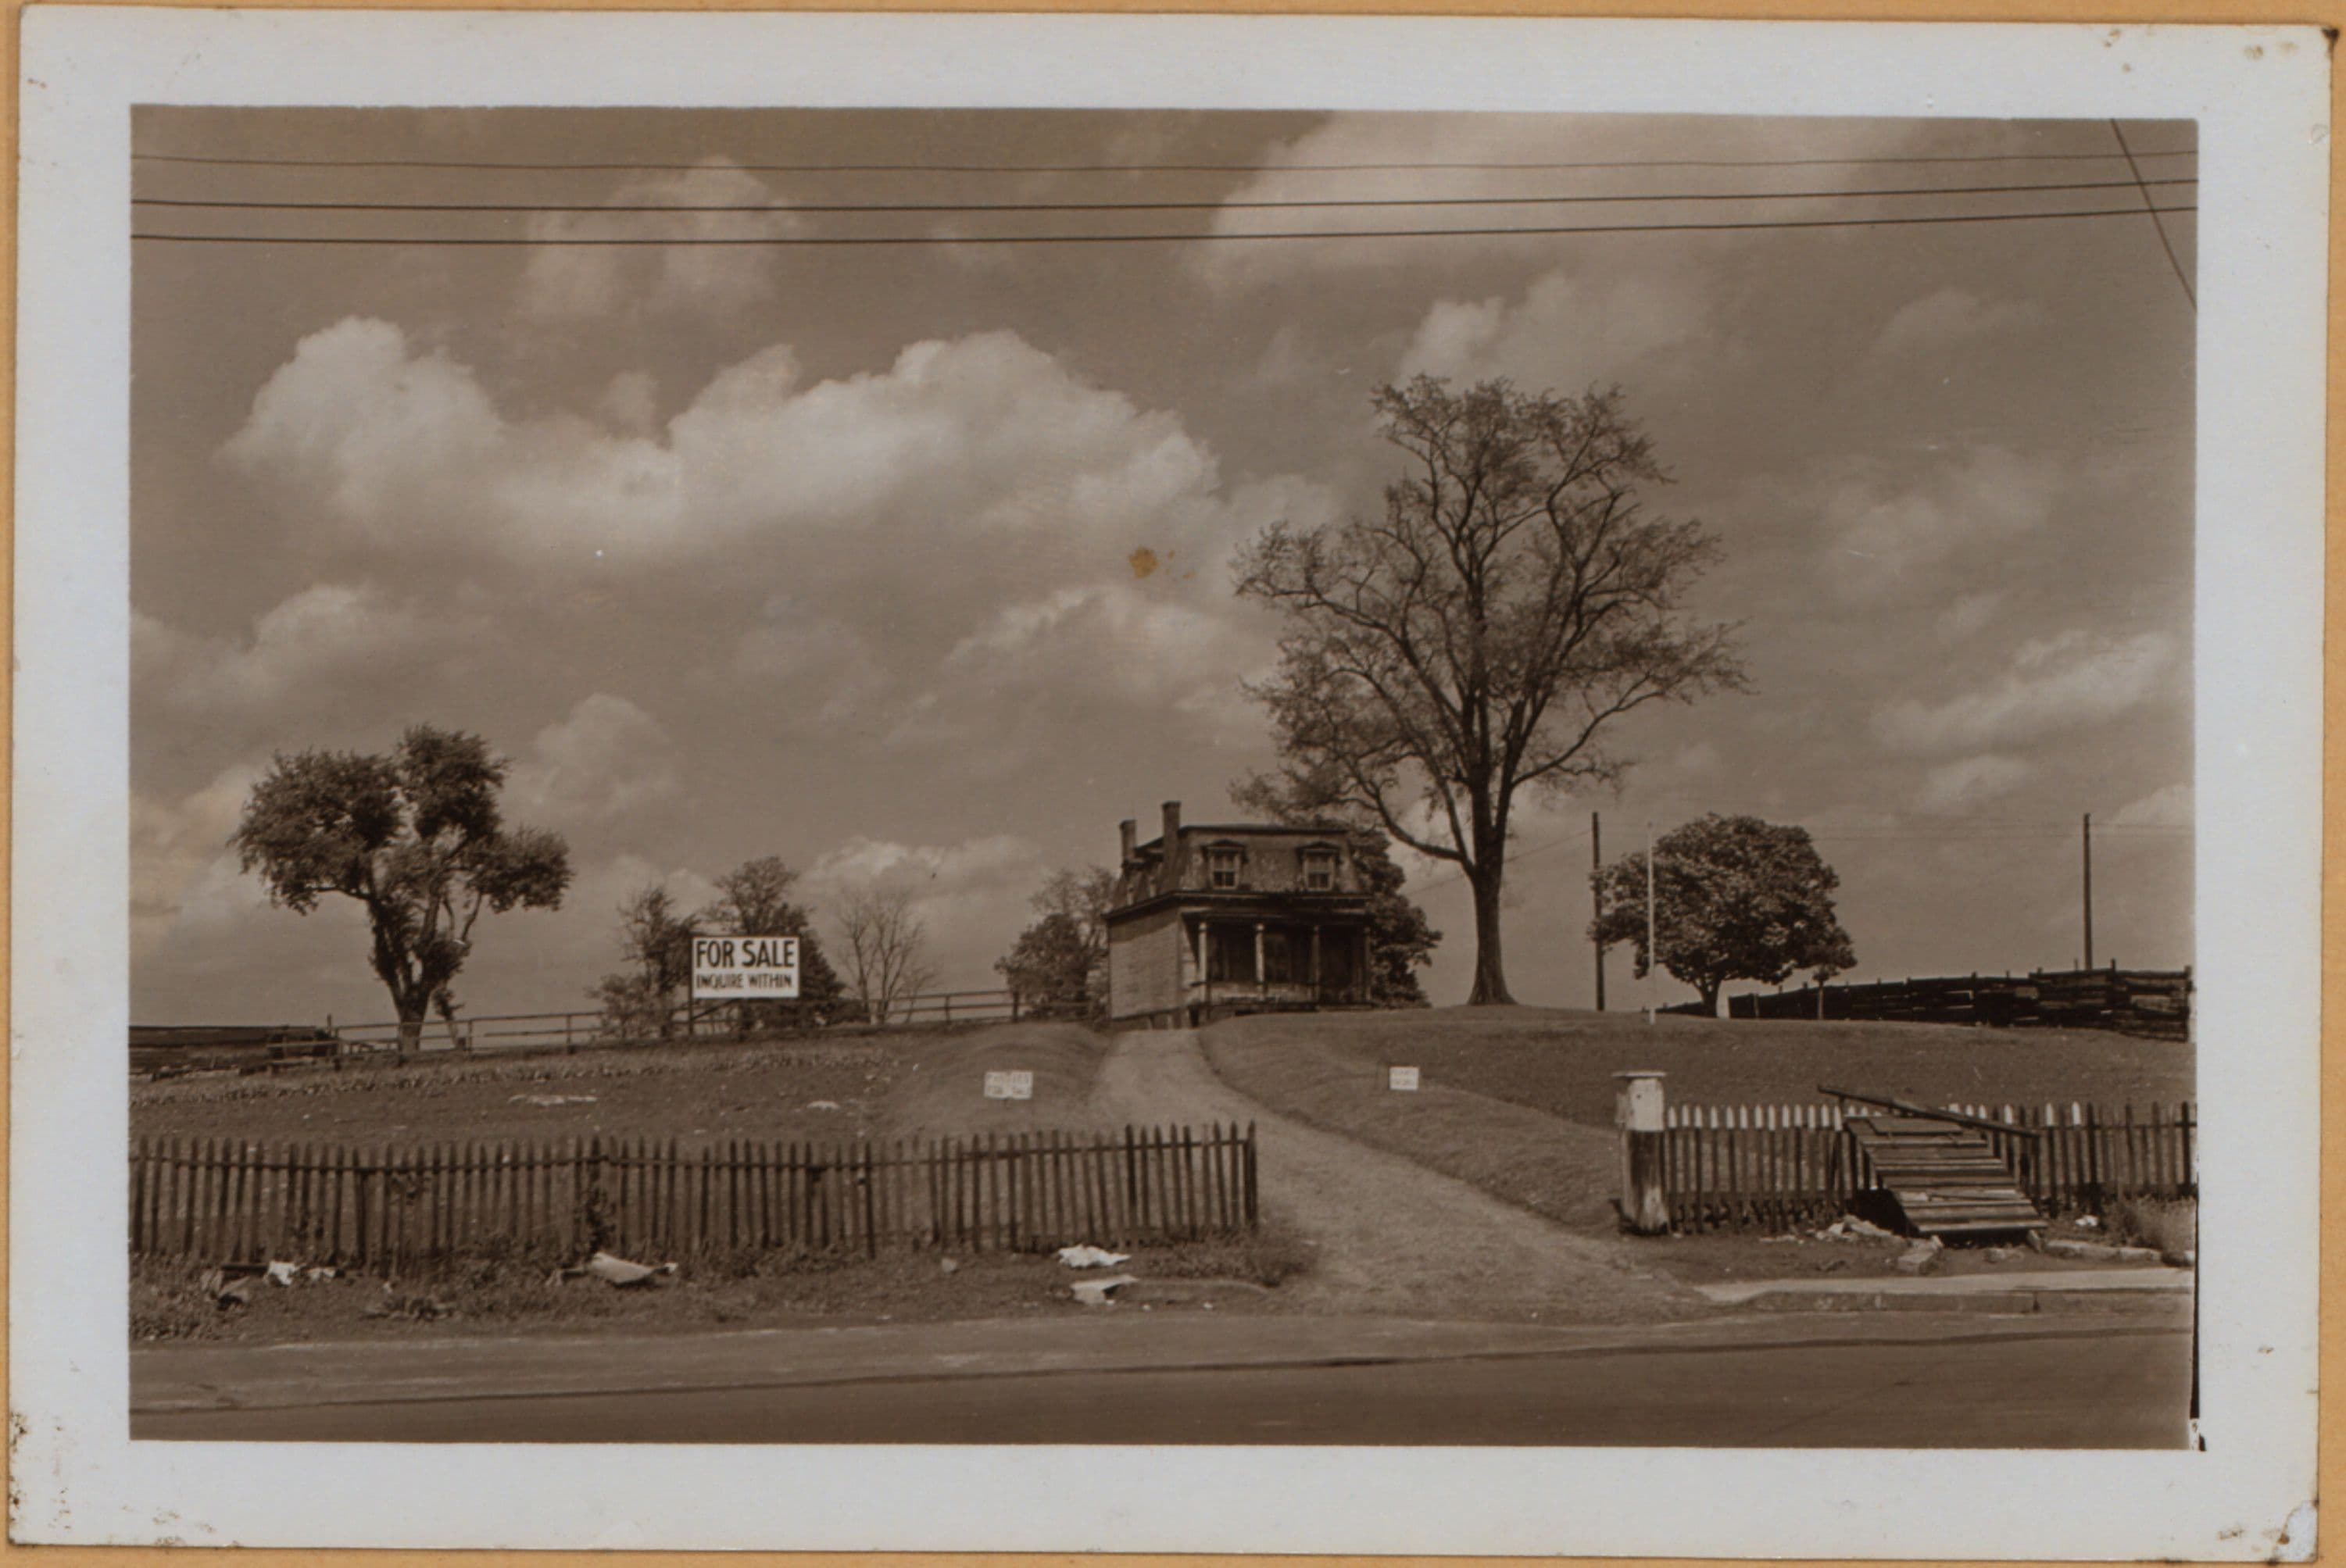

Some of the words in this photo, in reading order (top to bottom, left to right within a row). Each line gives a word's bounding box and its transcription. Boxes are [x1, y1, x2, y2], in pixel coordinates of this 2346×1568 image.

[697, 940, 734, 967] FOR
[742, 940, 795, 967] SALE
[697, 973, 744, 989] INQUIRE
[747, 973, 792, 988] WITHIN
